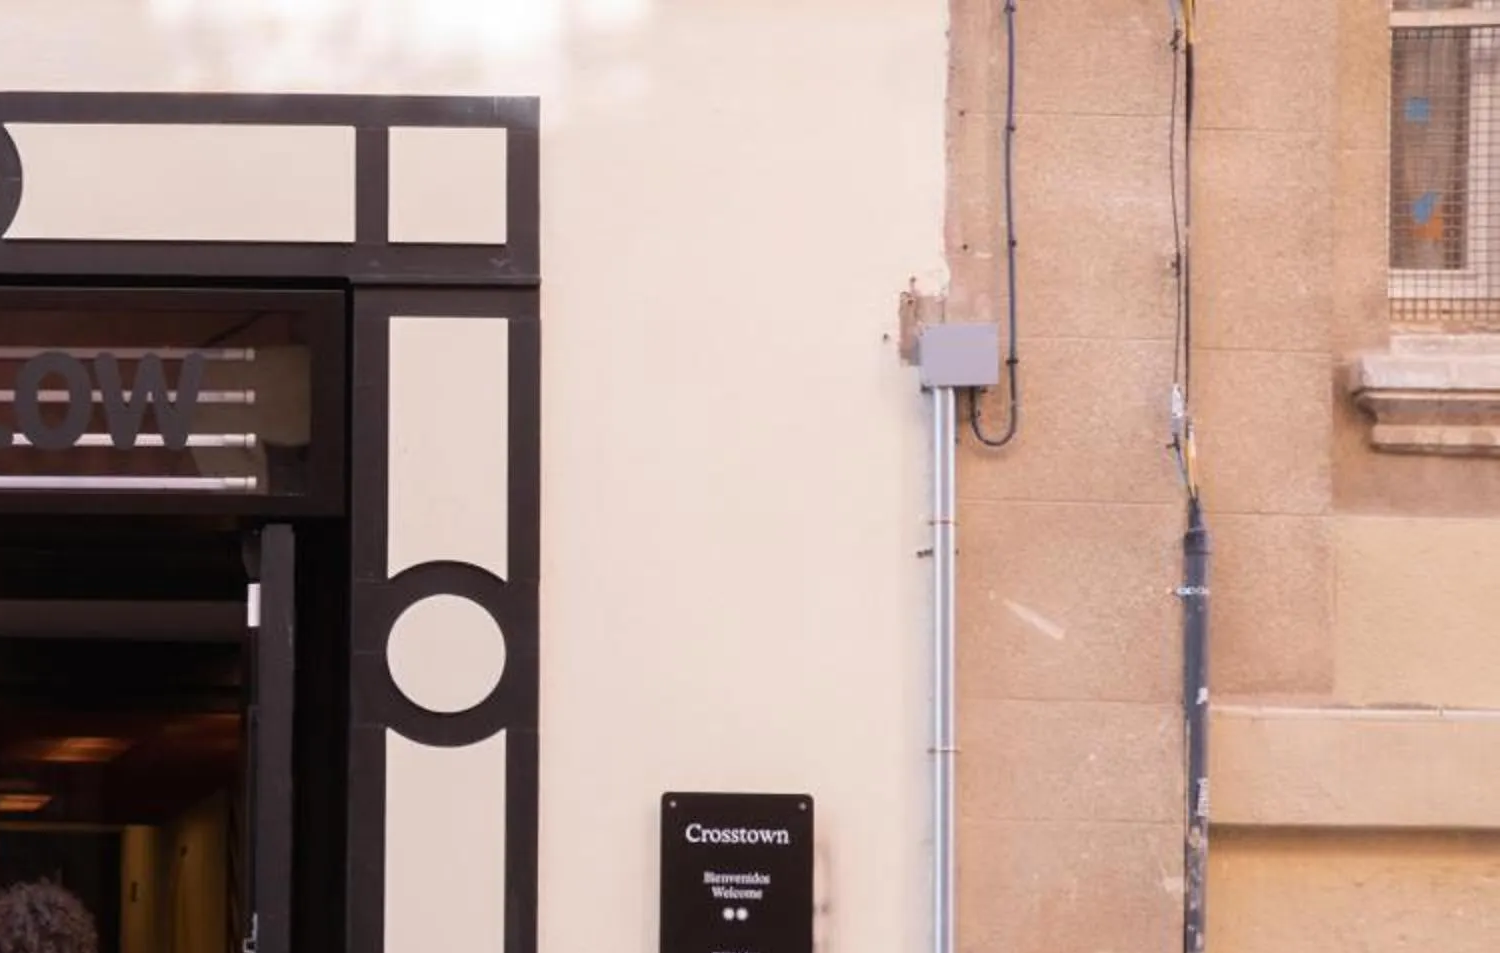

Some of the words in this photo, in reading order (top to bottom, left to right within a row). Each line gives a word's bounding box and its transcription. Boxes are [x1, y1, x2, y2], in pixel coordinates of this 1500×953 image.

[685, 823, 790, 844] Crosstown
[703, 871, 770, 885] Bienvenidos
[711, 886, 763, 899] Welcome
